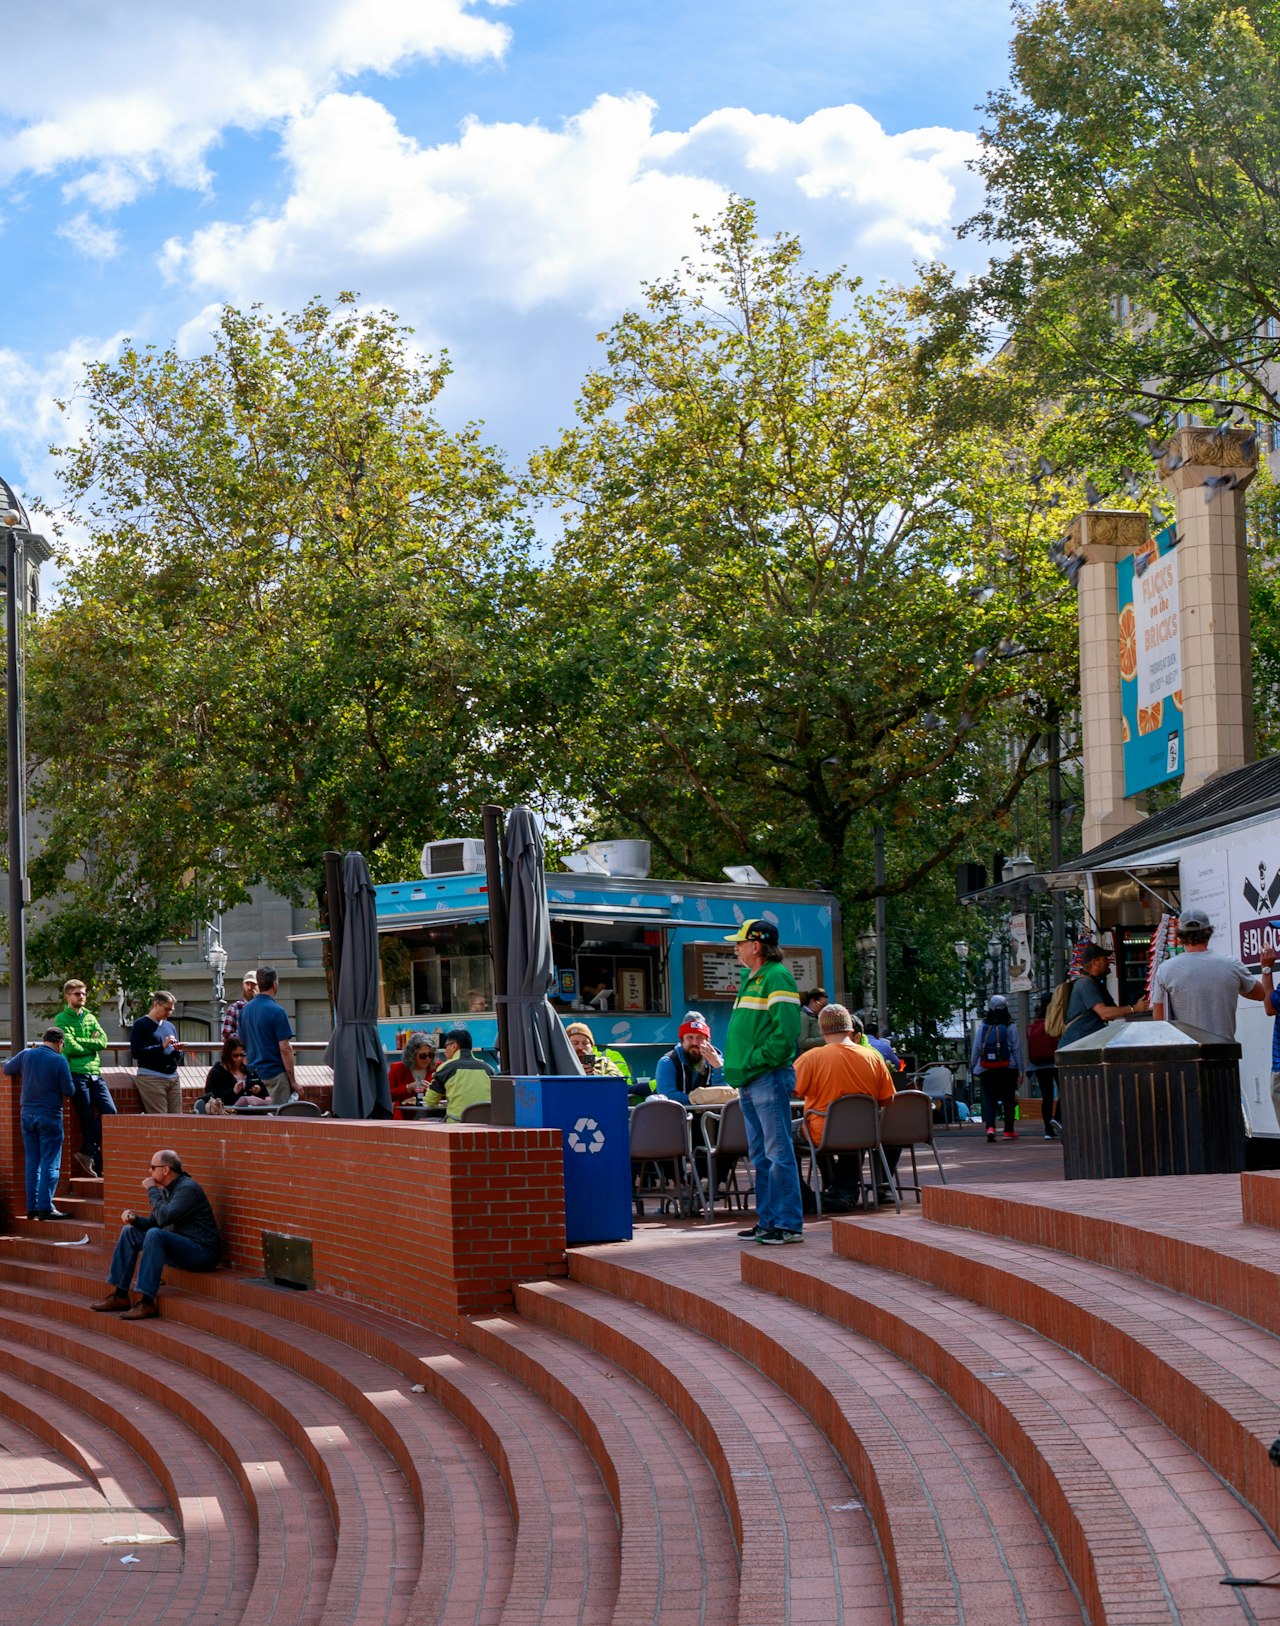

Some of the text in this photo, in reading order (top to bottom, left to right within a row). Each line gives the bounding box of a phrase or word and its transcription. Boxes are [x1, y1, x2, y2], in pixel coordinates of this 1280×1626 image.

[1142, 564, 1174, 601] FLICKS
[1150, 598, 1168, 618] on the
[1144, 613, 1178, 652] BRICKS
